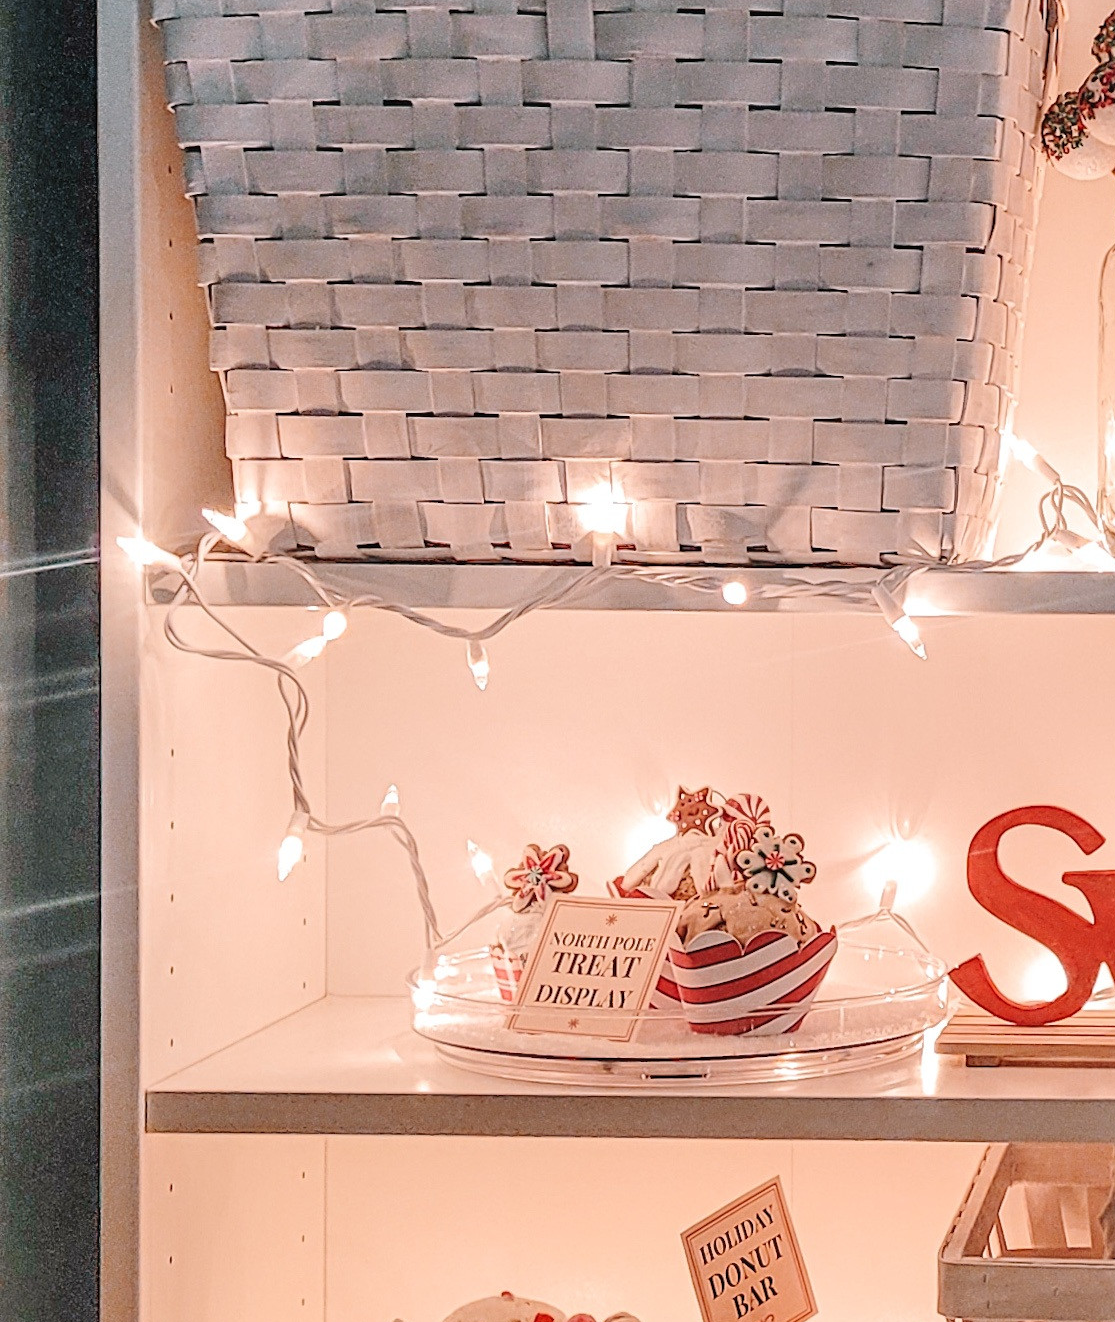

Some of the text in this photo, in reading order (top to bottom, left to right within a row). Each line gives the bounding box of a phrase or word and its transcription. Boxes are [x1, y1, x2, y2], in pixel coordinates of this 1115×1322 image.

[550, 931, 656, 952] NORTH POLE
[551, 951, 642, 979] TREAT
[534, 984, 633, 1009] DISPLAY
[700, 1204, 773, 1265] HOLIDAY
[707, 1234, 783, 1300] DONUT
[732, 1276, 778, 1320] BAR
